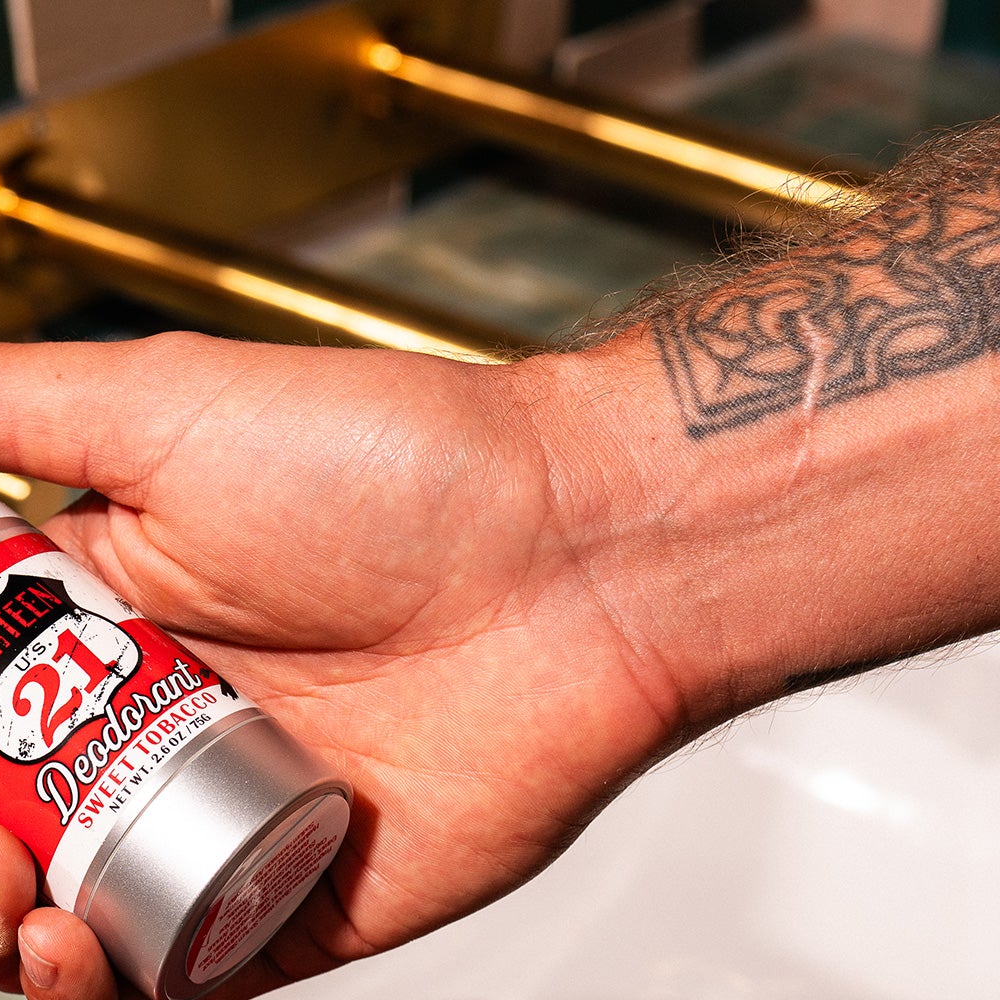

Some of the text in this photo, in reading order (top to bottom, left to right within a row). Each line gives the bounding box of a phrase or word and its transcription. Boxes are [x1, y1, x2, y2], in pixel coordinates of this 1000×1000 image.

[12, 628, 117, 749] 21
[14, 642, 52, 672] U.S.
[36, 658, 202, 826] Deodorant
[78, 692, 217, 829] SWEET TOBACCO
[109, 785, 132, 813] NET
[129, 764, 153, 786] WT.
[151, 745, 170, 764] 2.6
[168, 731, 187, 747] OZ
[189, 713, 211, 729] 75G
